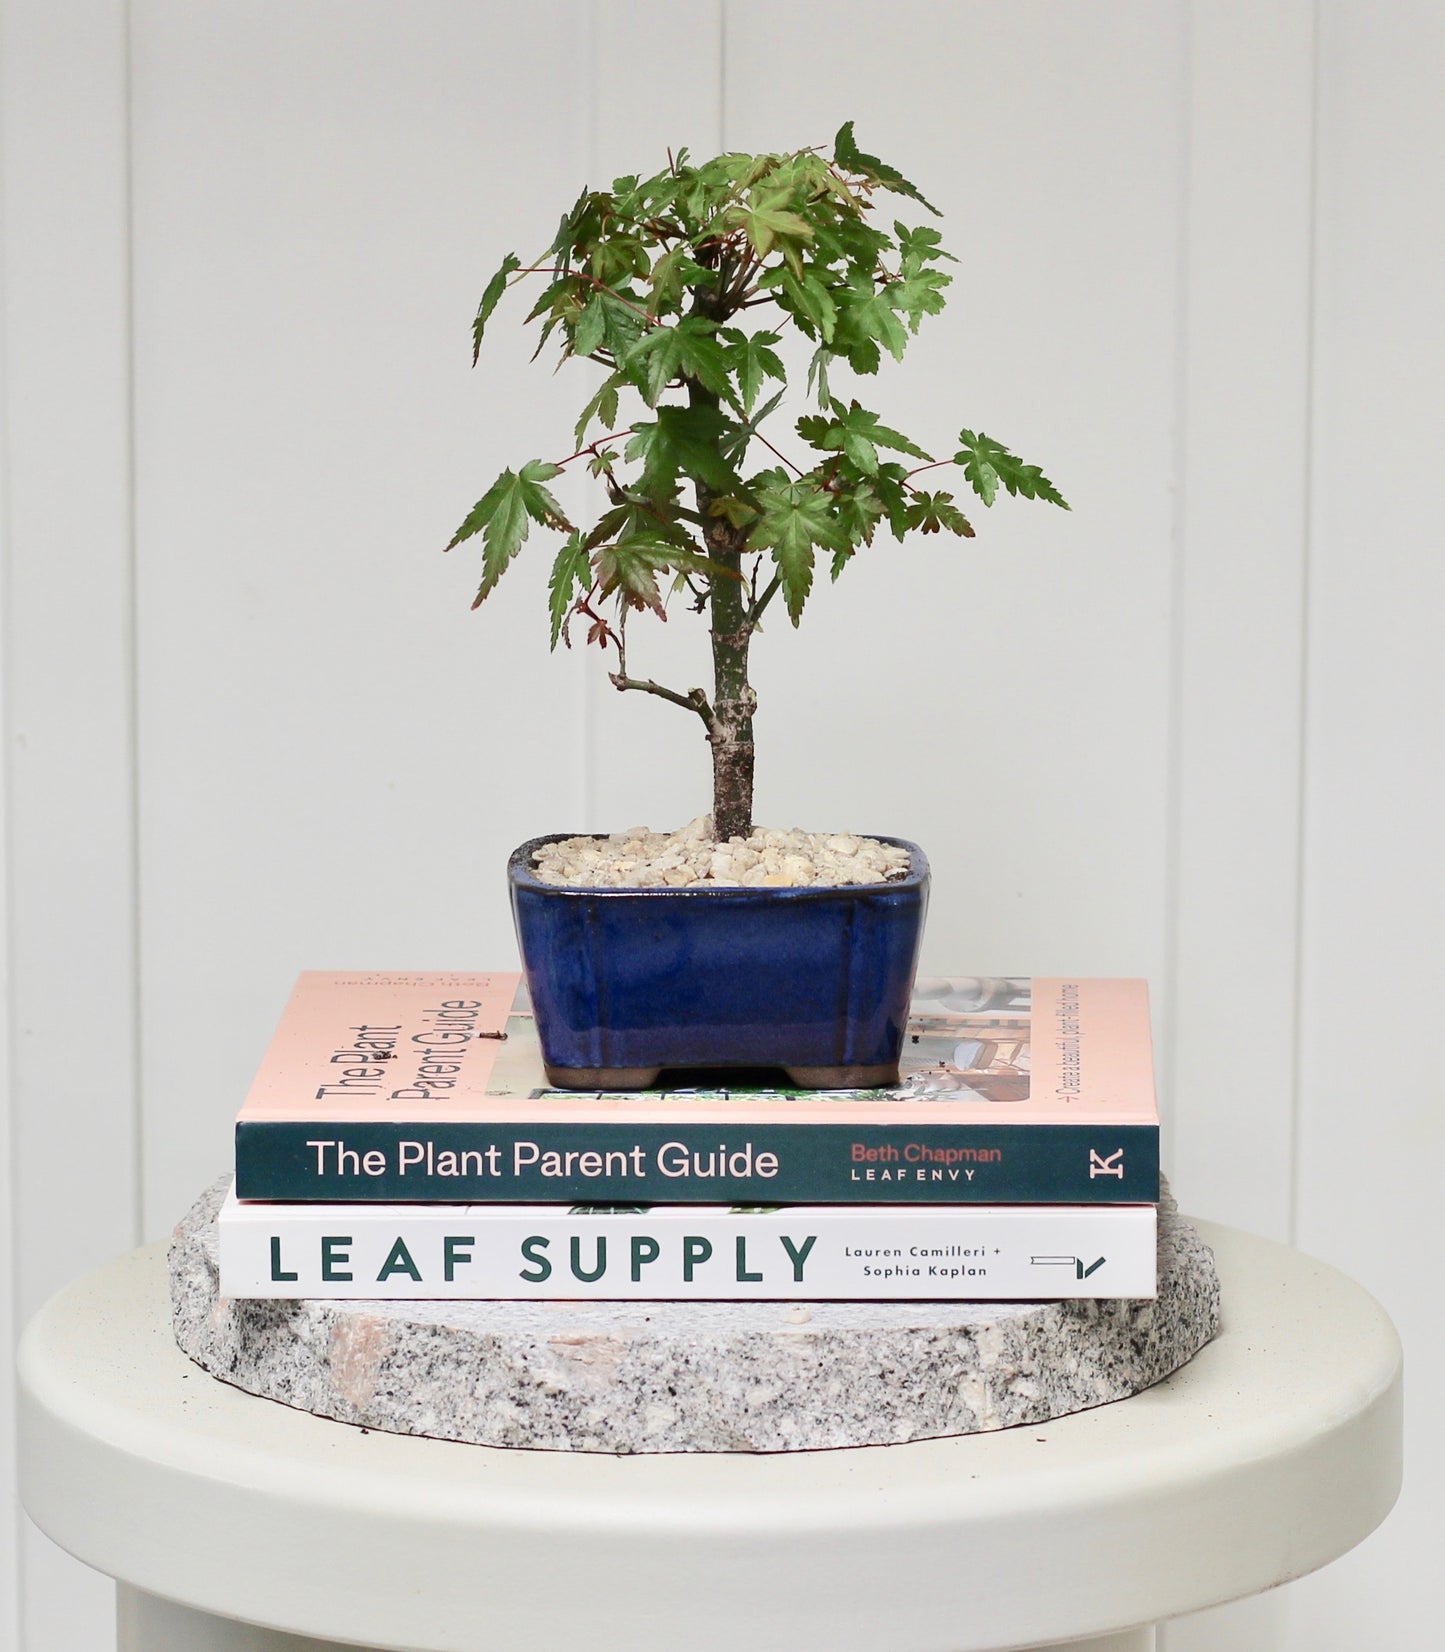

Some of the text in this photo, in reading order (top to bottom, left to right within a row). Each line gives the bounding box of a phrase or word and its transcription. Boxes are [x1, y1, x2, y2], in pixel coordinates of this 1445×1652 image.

[315, 1025, 402, 1100] The Plant
[390, 1000, 482, 1100] Parent Guide
[1055, 1071, 1081, 1095] Create
[307, 1140, 779, 1178] The Plant Parent Guide
[851, 1143, 1002, 1166] Beth Chapman
[1089, 1148, 1124, 1180] K
[851, 1168, 976, 1181] LEAF ENVY
[271, 1236, 818, 1282] LEAF SUPPLY
[845, 1246, 903, 1258] Lauren
[909, 1245, 986, 1258] Camilleri
[863, 1265, 988, 1279] Sophia Kaplan
